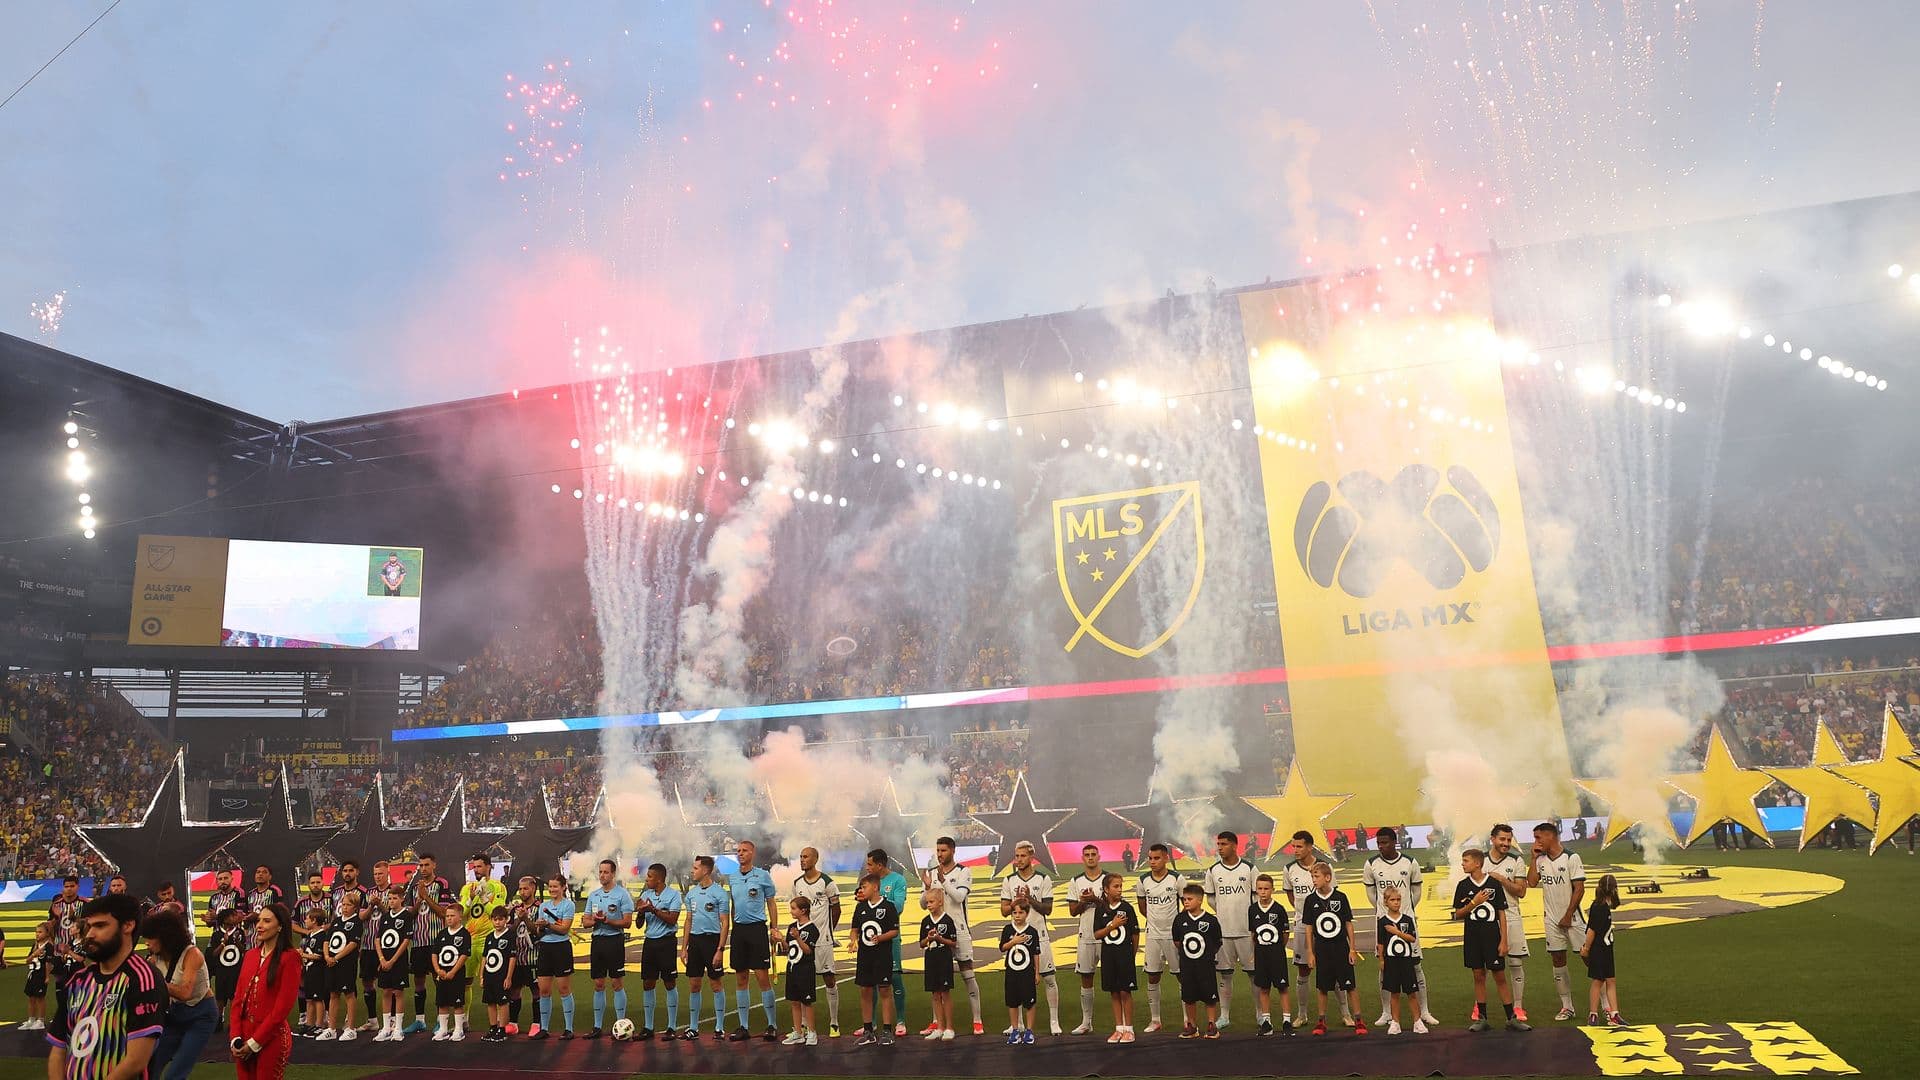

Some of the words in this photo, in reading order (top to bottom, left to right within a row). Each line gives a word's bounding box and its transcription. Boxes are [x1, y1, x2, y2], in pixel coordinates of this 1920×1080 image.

[1066, 503, 1144, 543] MLS
[144, 584, 192, 592] ALL-STAR
[144, 593, 175, 601] GAME
[1343, 608, 1412, 635] LIGA
[1541, 874, 1565, 885] BBVA
[1219, 886, 1245, 895] BBVA
[1294, 885, 1316, 894] BBV
[1147, 895, 1172, 905] BBVA
